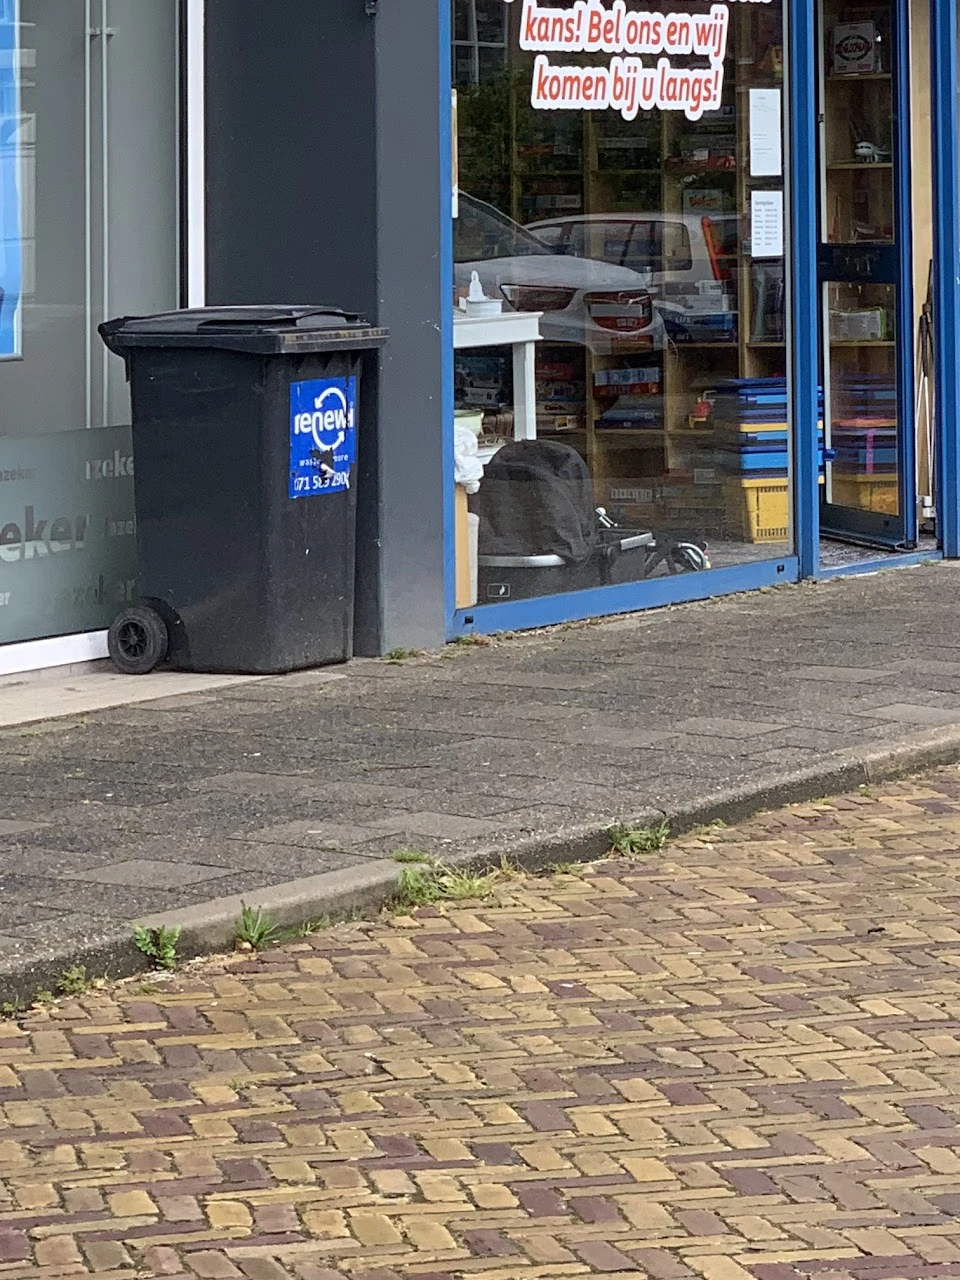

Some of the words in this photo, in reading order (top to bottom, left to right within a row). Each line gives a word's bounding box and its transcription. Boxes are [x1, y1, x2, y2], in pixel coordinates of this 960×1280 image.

[524, 5, 583, 43] kans!
[587, 9, 621, 45] Bel
[626, 18, 662, 45] ons
[667, 21, 690, 46] en
[695, 13, 724, 58] wij
[536, 64, 607, 100] komen
[612, 66, 638, 111] bij
[642, 75, 651, 101] u
[659, 67, 719, 112] langs!
[293, 401, 354, 435] renewi
